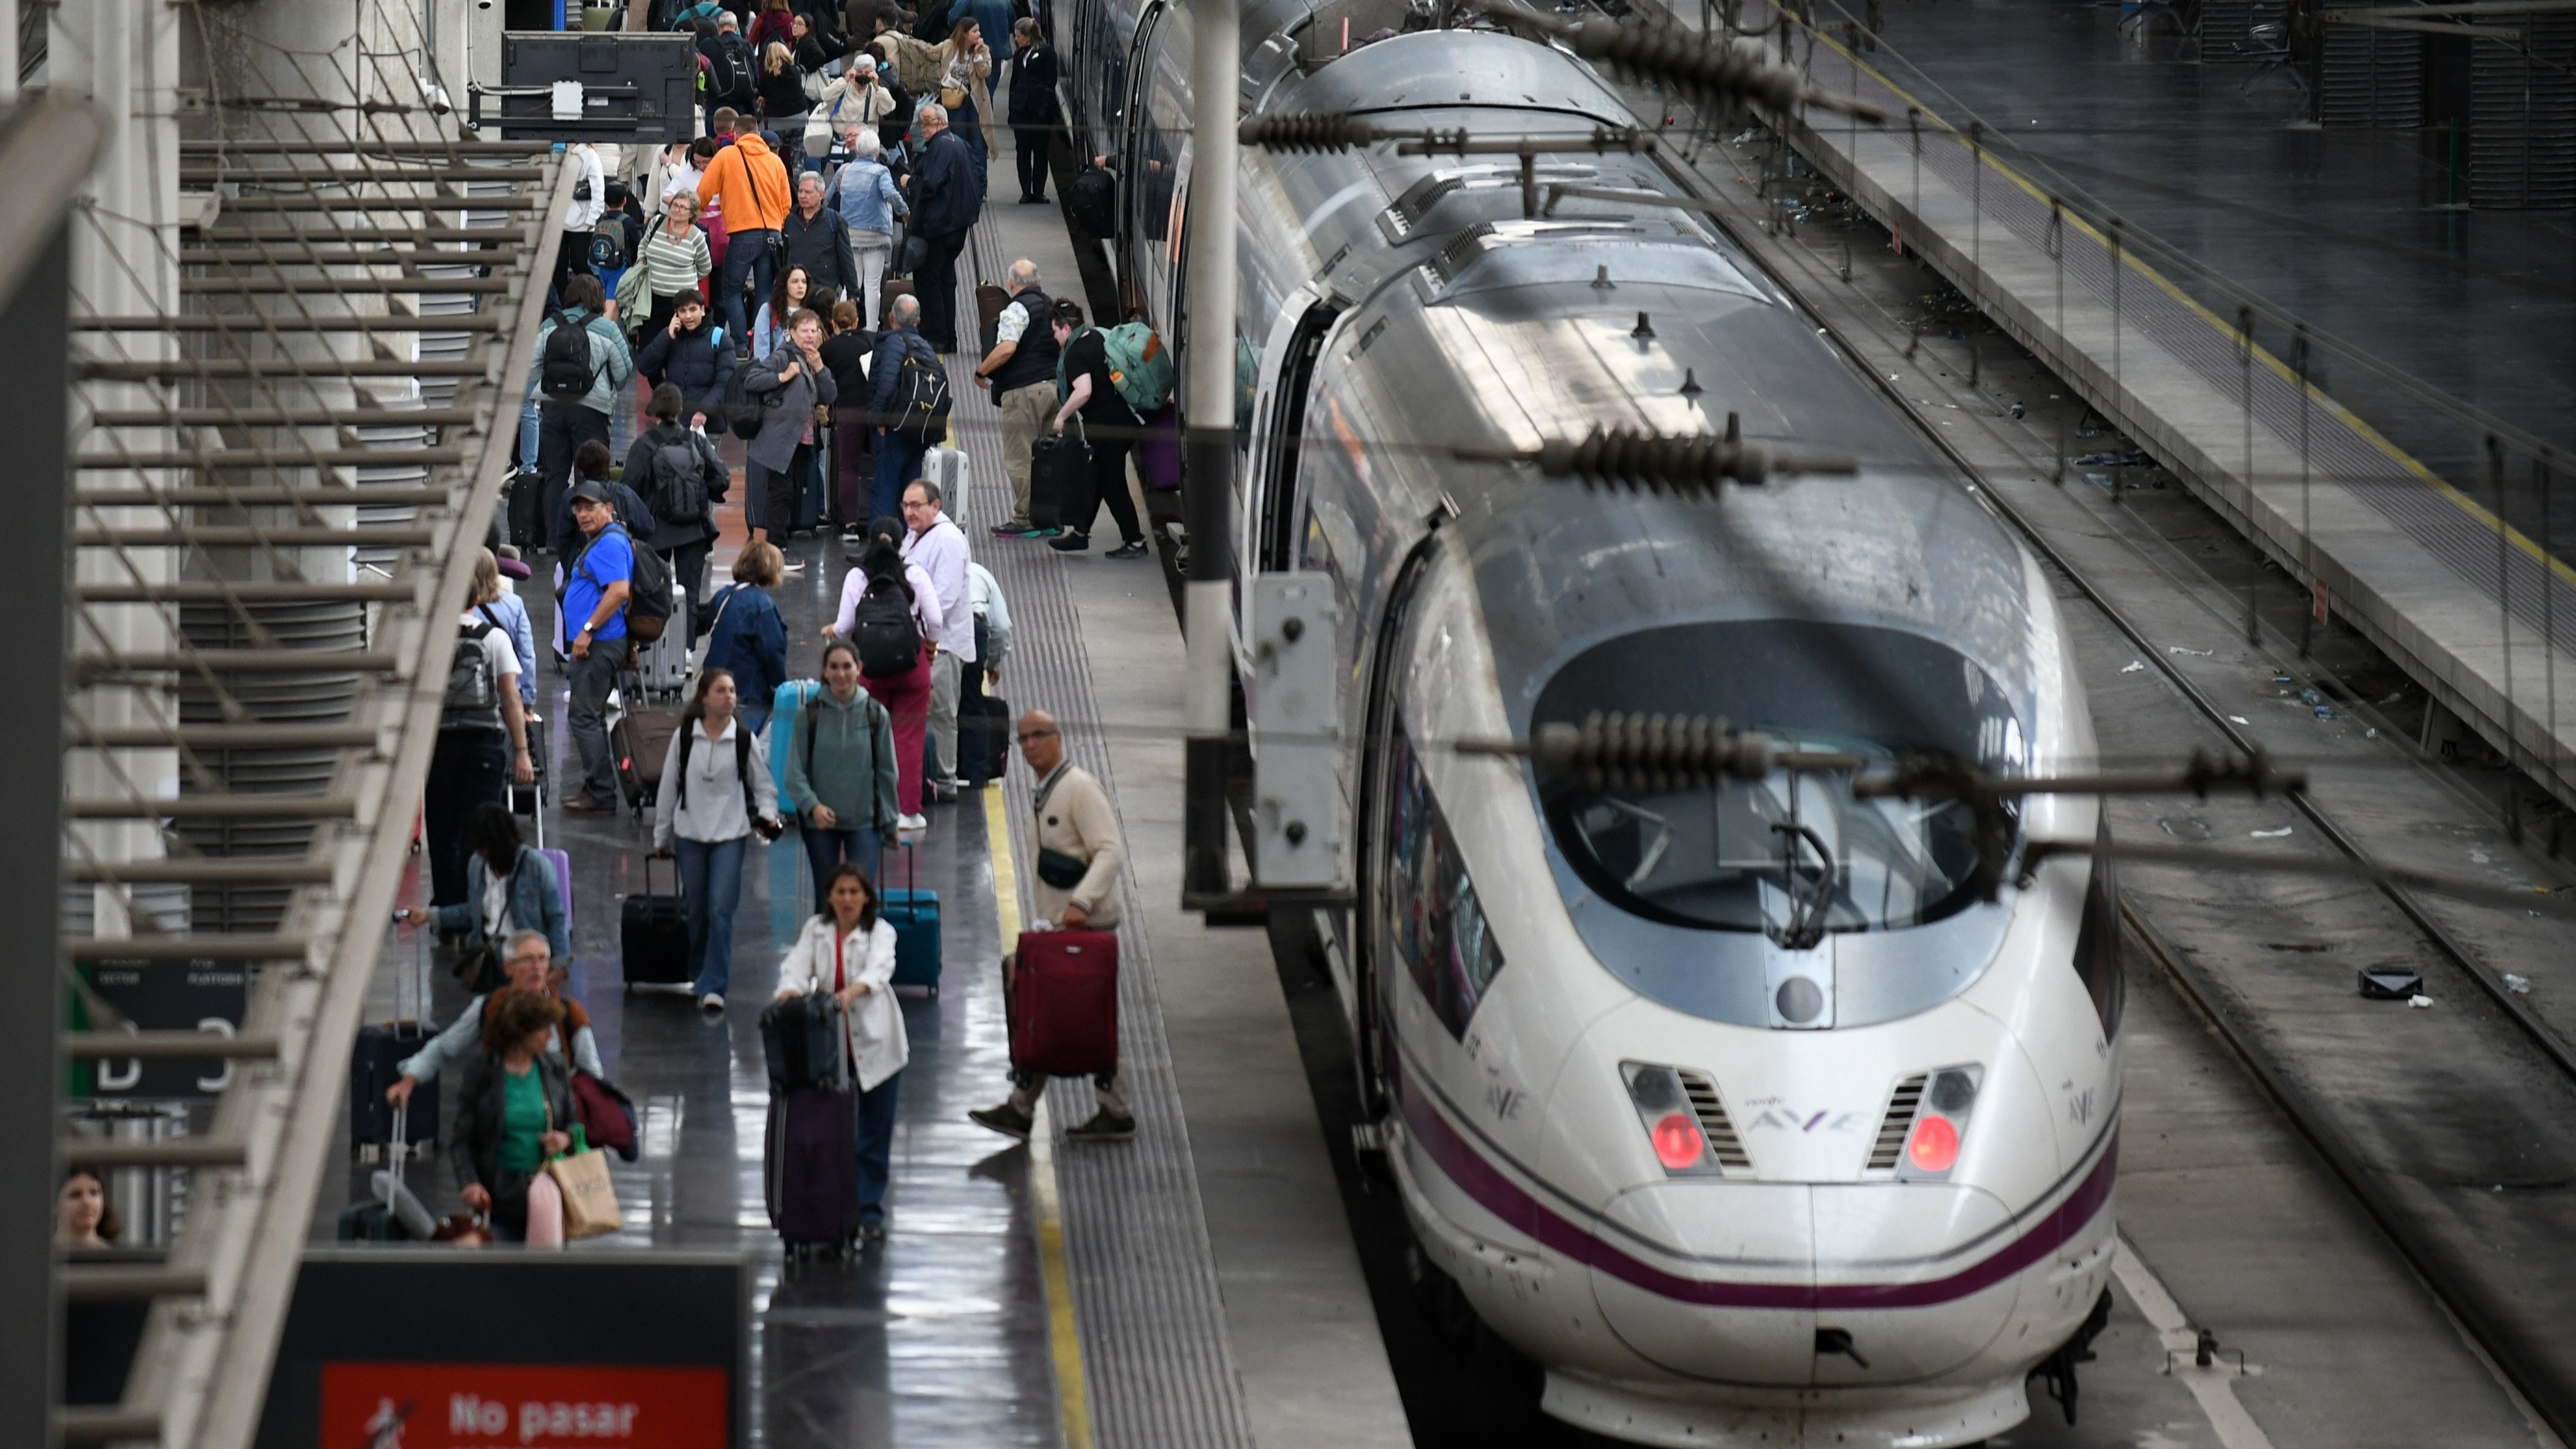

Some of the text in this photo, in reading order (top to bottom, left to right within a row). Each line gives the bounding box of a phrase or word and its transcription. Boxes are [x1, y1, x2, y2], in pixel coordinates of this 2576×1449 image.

[1747, 1107, 1872, 1133] AVE
[450, 1393, 638, 1444] No pasar
